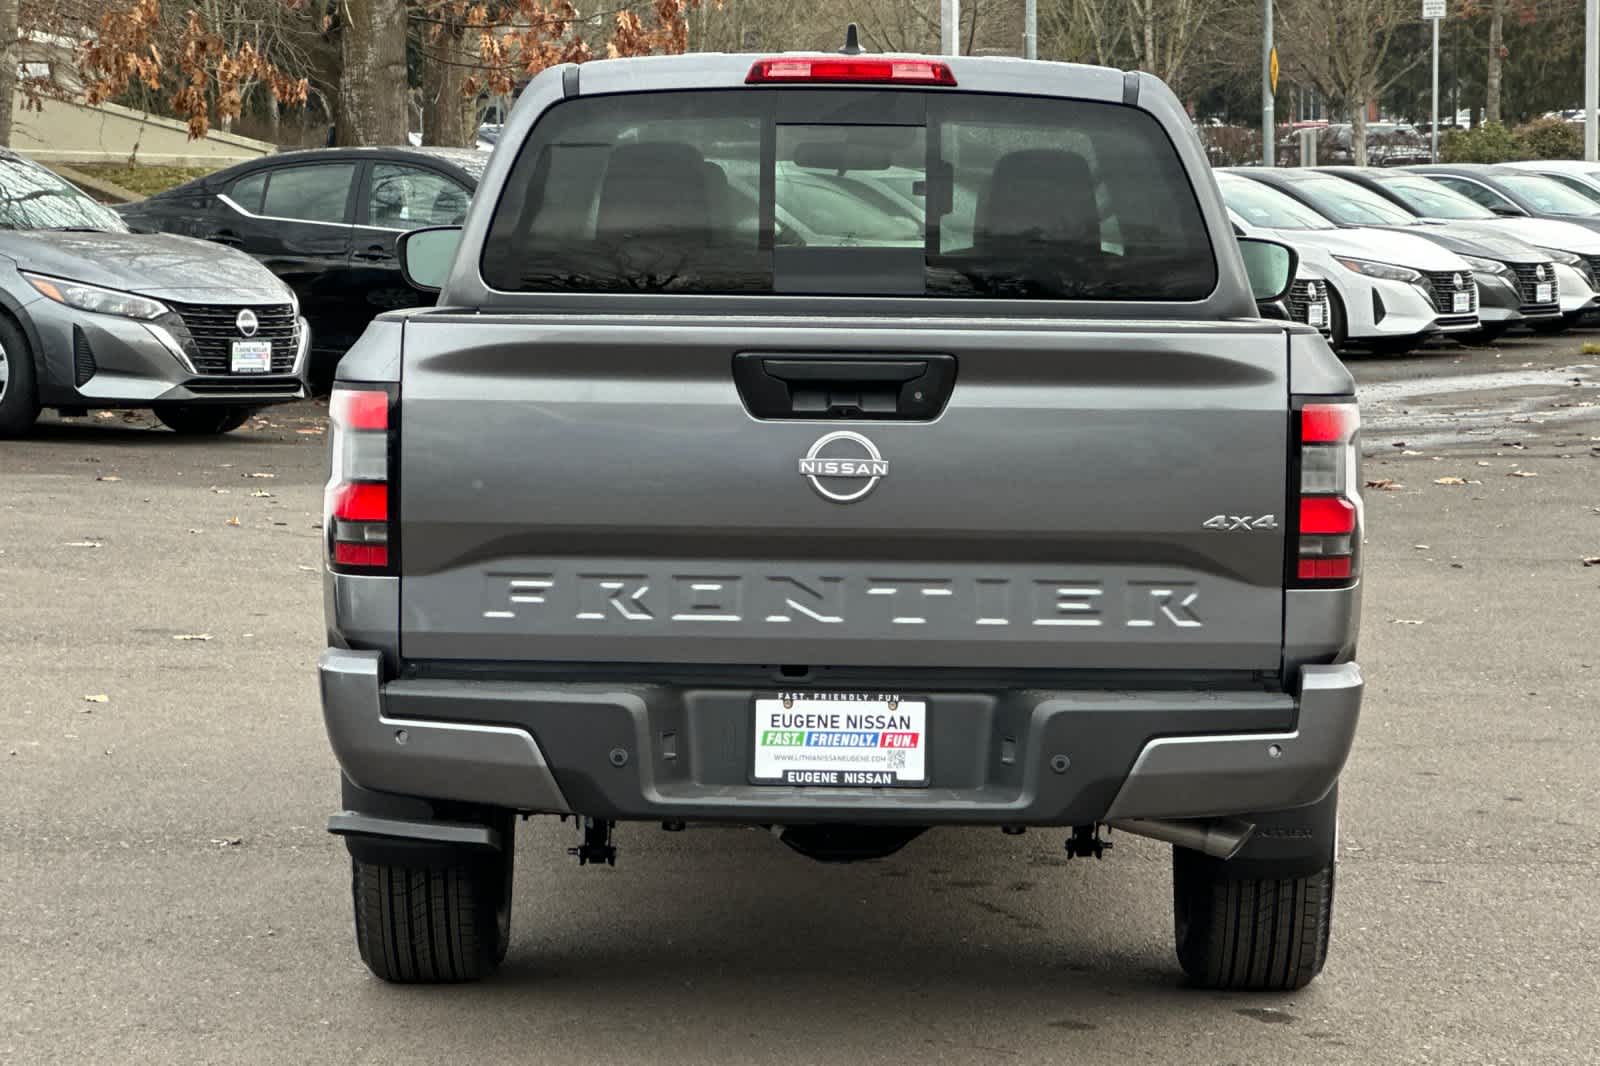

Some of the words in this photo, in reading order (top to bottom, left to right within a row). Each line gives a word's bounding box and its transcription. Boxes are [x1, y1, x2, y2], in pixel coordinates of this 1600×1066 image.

[801, 461, 887, 475] NISSAN
[483, 572, 1204, 627] FRONTIER
[771, 714, 840, 728] EUGENE
[846, 715, 911, 729] NISSAN
[766, 733, 801, 745] FAST.
[810, 733, 876, 747] FRIENDLY.
[884, 734, 916, 747] FUN.
[787, 772, 838, 783] EUGENE
[844, 773, 892, 784] NISSAN
